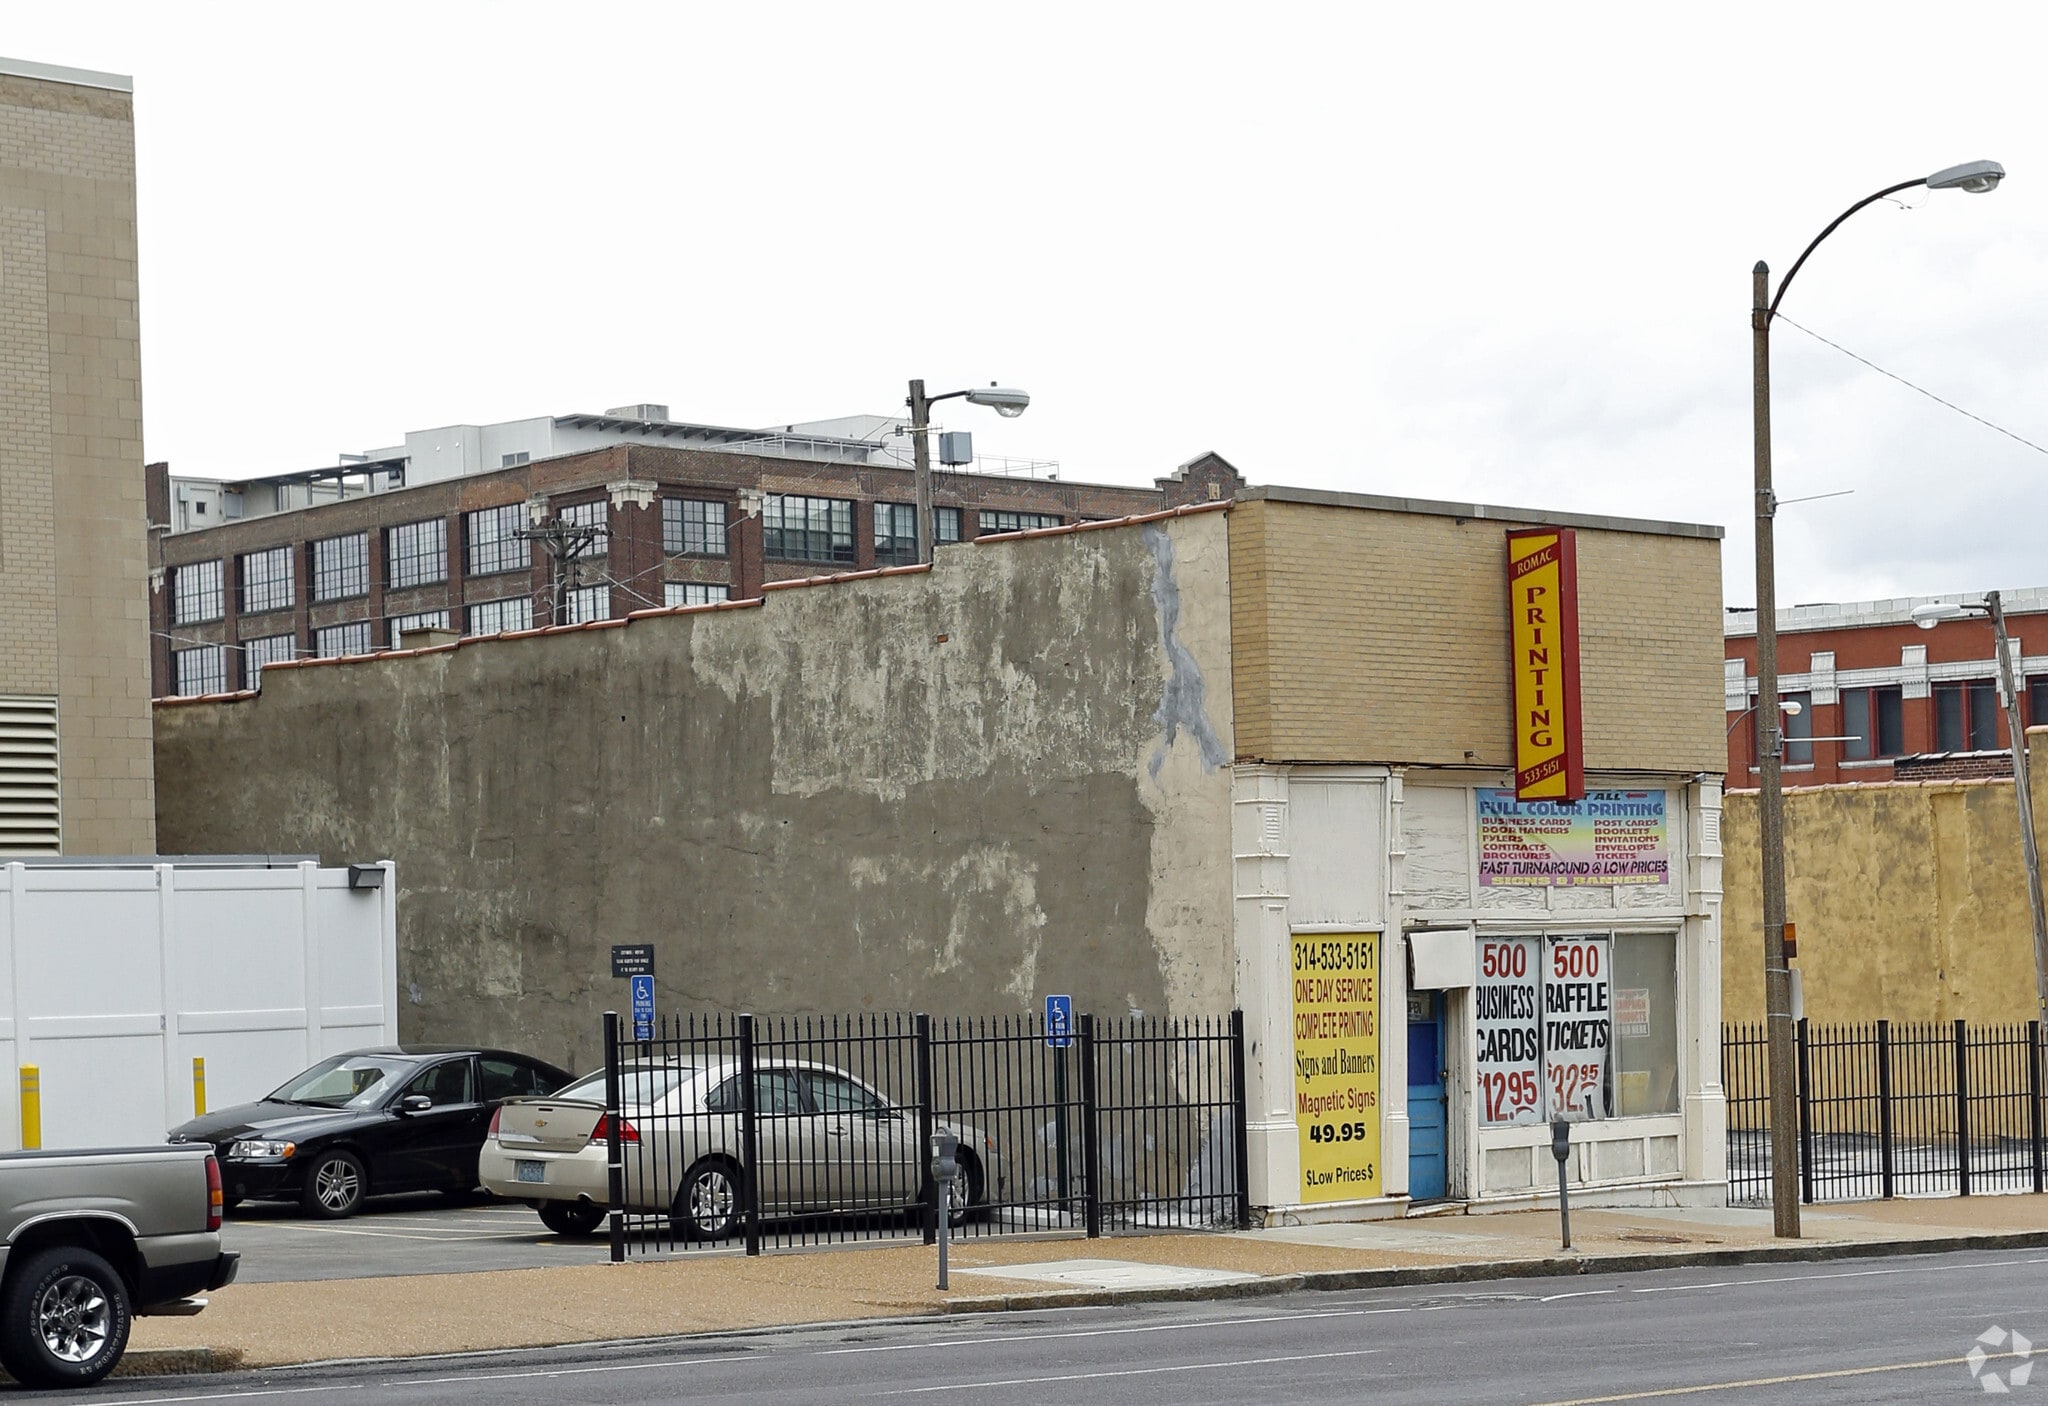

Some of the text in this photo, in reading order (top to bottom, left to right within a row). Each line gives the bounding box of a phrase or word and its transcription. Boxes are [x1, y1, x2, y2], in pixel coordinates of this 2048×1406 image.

[1517, 549, 1552, 575] ROMAC
[1527, 586, 1552, 747] PRINTING
[1480, 801, 1663, 816] FULL COLOR PRINTING
[1482, 817, 1536, 825] BUSINESS
[1482, 826, 1516, 834] DOOR
[1480, 861, 1509, 874] FAST
[1512, 861, 1590, 874] TURNAROUND
[1604, 861, 1629, 874] LOW
[1630, 860, 1668, 874] PRICES
[1483, 852, 1551, 860] BROCHURES
[1492, 876, 1551, 885] SIGNS
[1573, 875, 1660, 885] BANNERS
[1295, 942, 1373, 970] 314-533-5151
[1483, 944, 1526, 978] 500
[1554, 945, 1599, 978] 500
[1296, 978, 1373, 1003] ONE DAY SERVICE
[1477, 985, 1534, 1020] BUSINESS
[1546, 982, 1608, 1013] RAFFLE
[1296, 1010, 1373, 1040] COMPLETE PRINTING
[1547, 1019, 1609, 1051] TICKETS
[1477, 1028, 1537, 1062] CARDS
[1296, 1048, 1375, 1084] Signs and Banners
[1298, 1088, 1375, 1118] Magnetic Signs
[1310, 1122, 1365, 1143] 49.95
[1306, 1169, 1333, 1187] $Low
